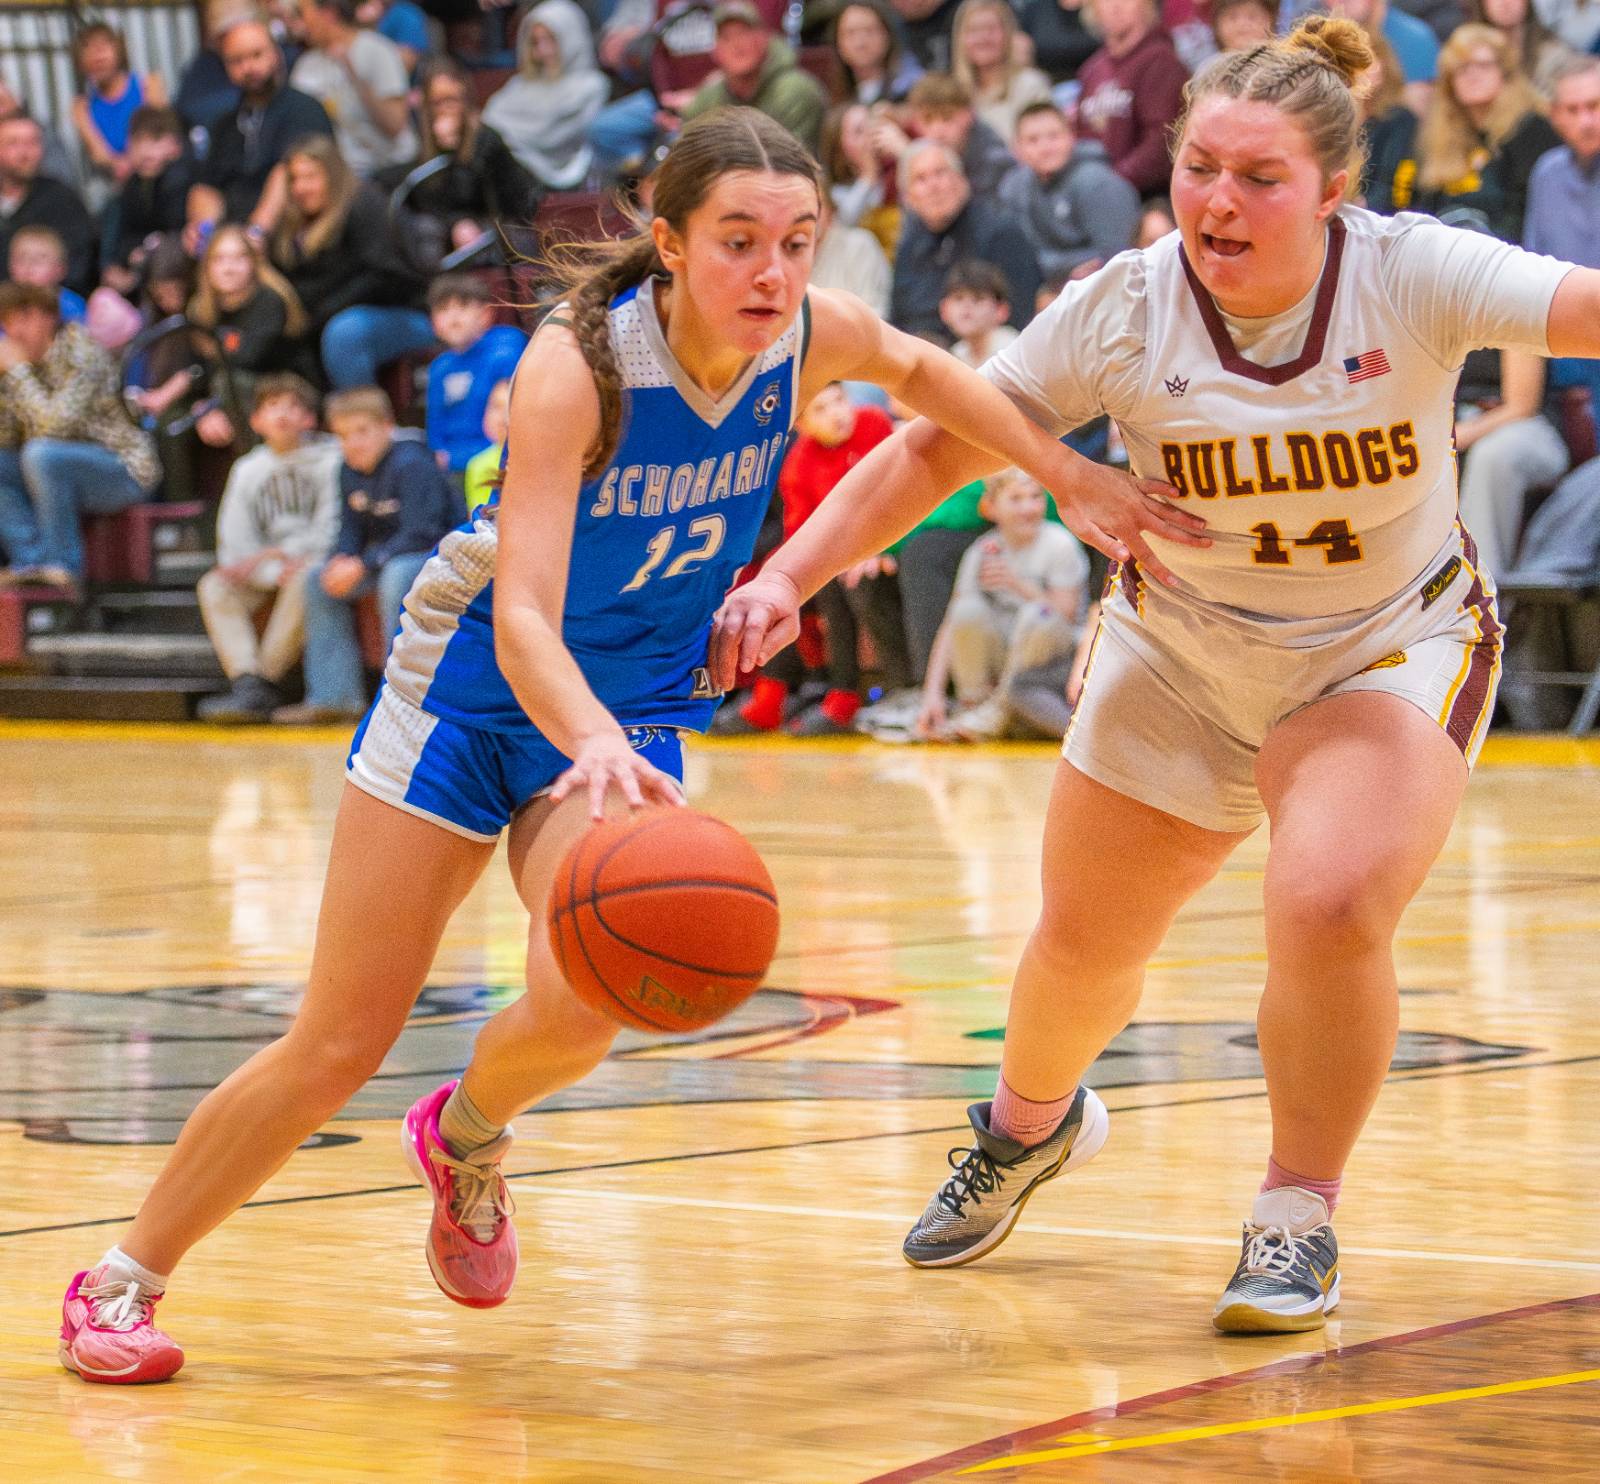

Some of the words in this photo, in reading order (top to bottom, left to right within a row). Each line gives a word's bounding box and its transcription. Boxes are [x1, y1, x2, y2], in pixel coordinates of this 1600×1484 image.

[1160, 418, 1421, 500] BULLDOGS
[618, 512, 727, 594] 12
[1250, 517, 1365, 566] 14
